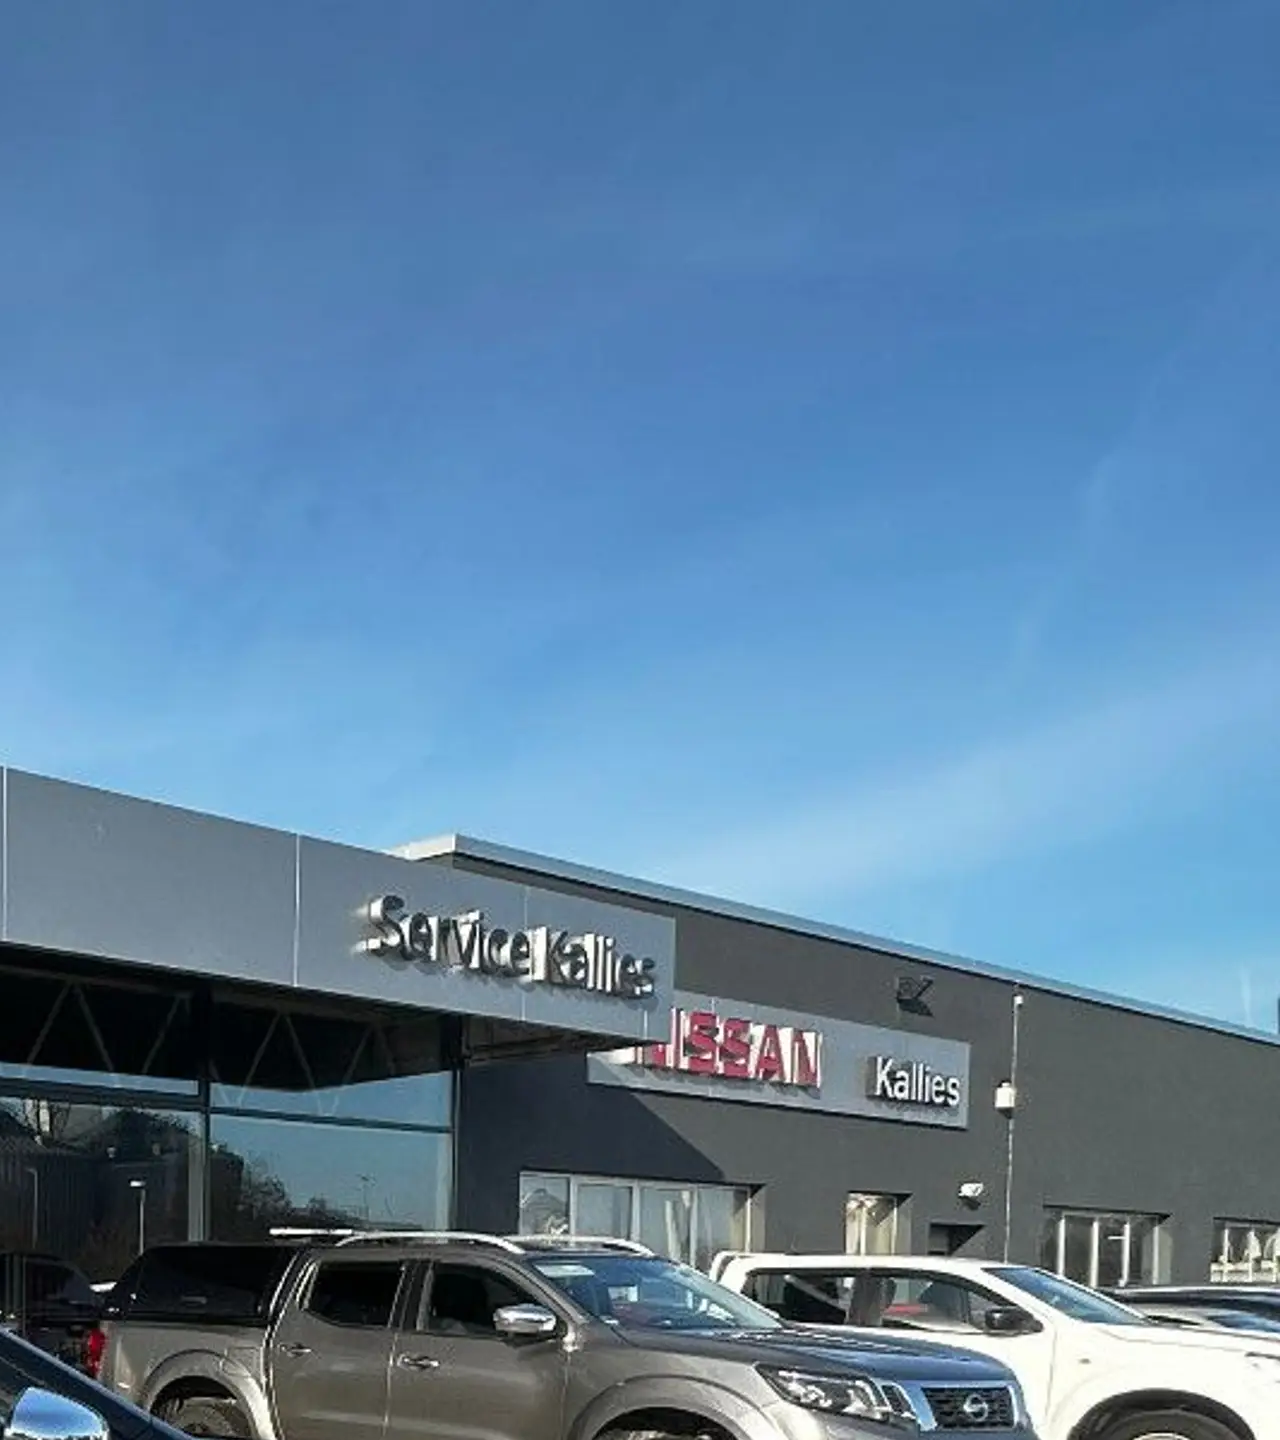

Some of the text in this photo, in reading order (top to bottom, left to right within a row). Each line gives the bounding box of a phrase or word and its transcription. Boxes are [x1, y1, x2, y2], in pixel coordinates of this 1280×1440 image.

[364, 894, 655, 999] Service Kallies
[874, 1055, 961, 1106] Kallies
